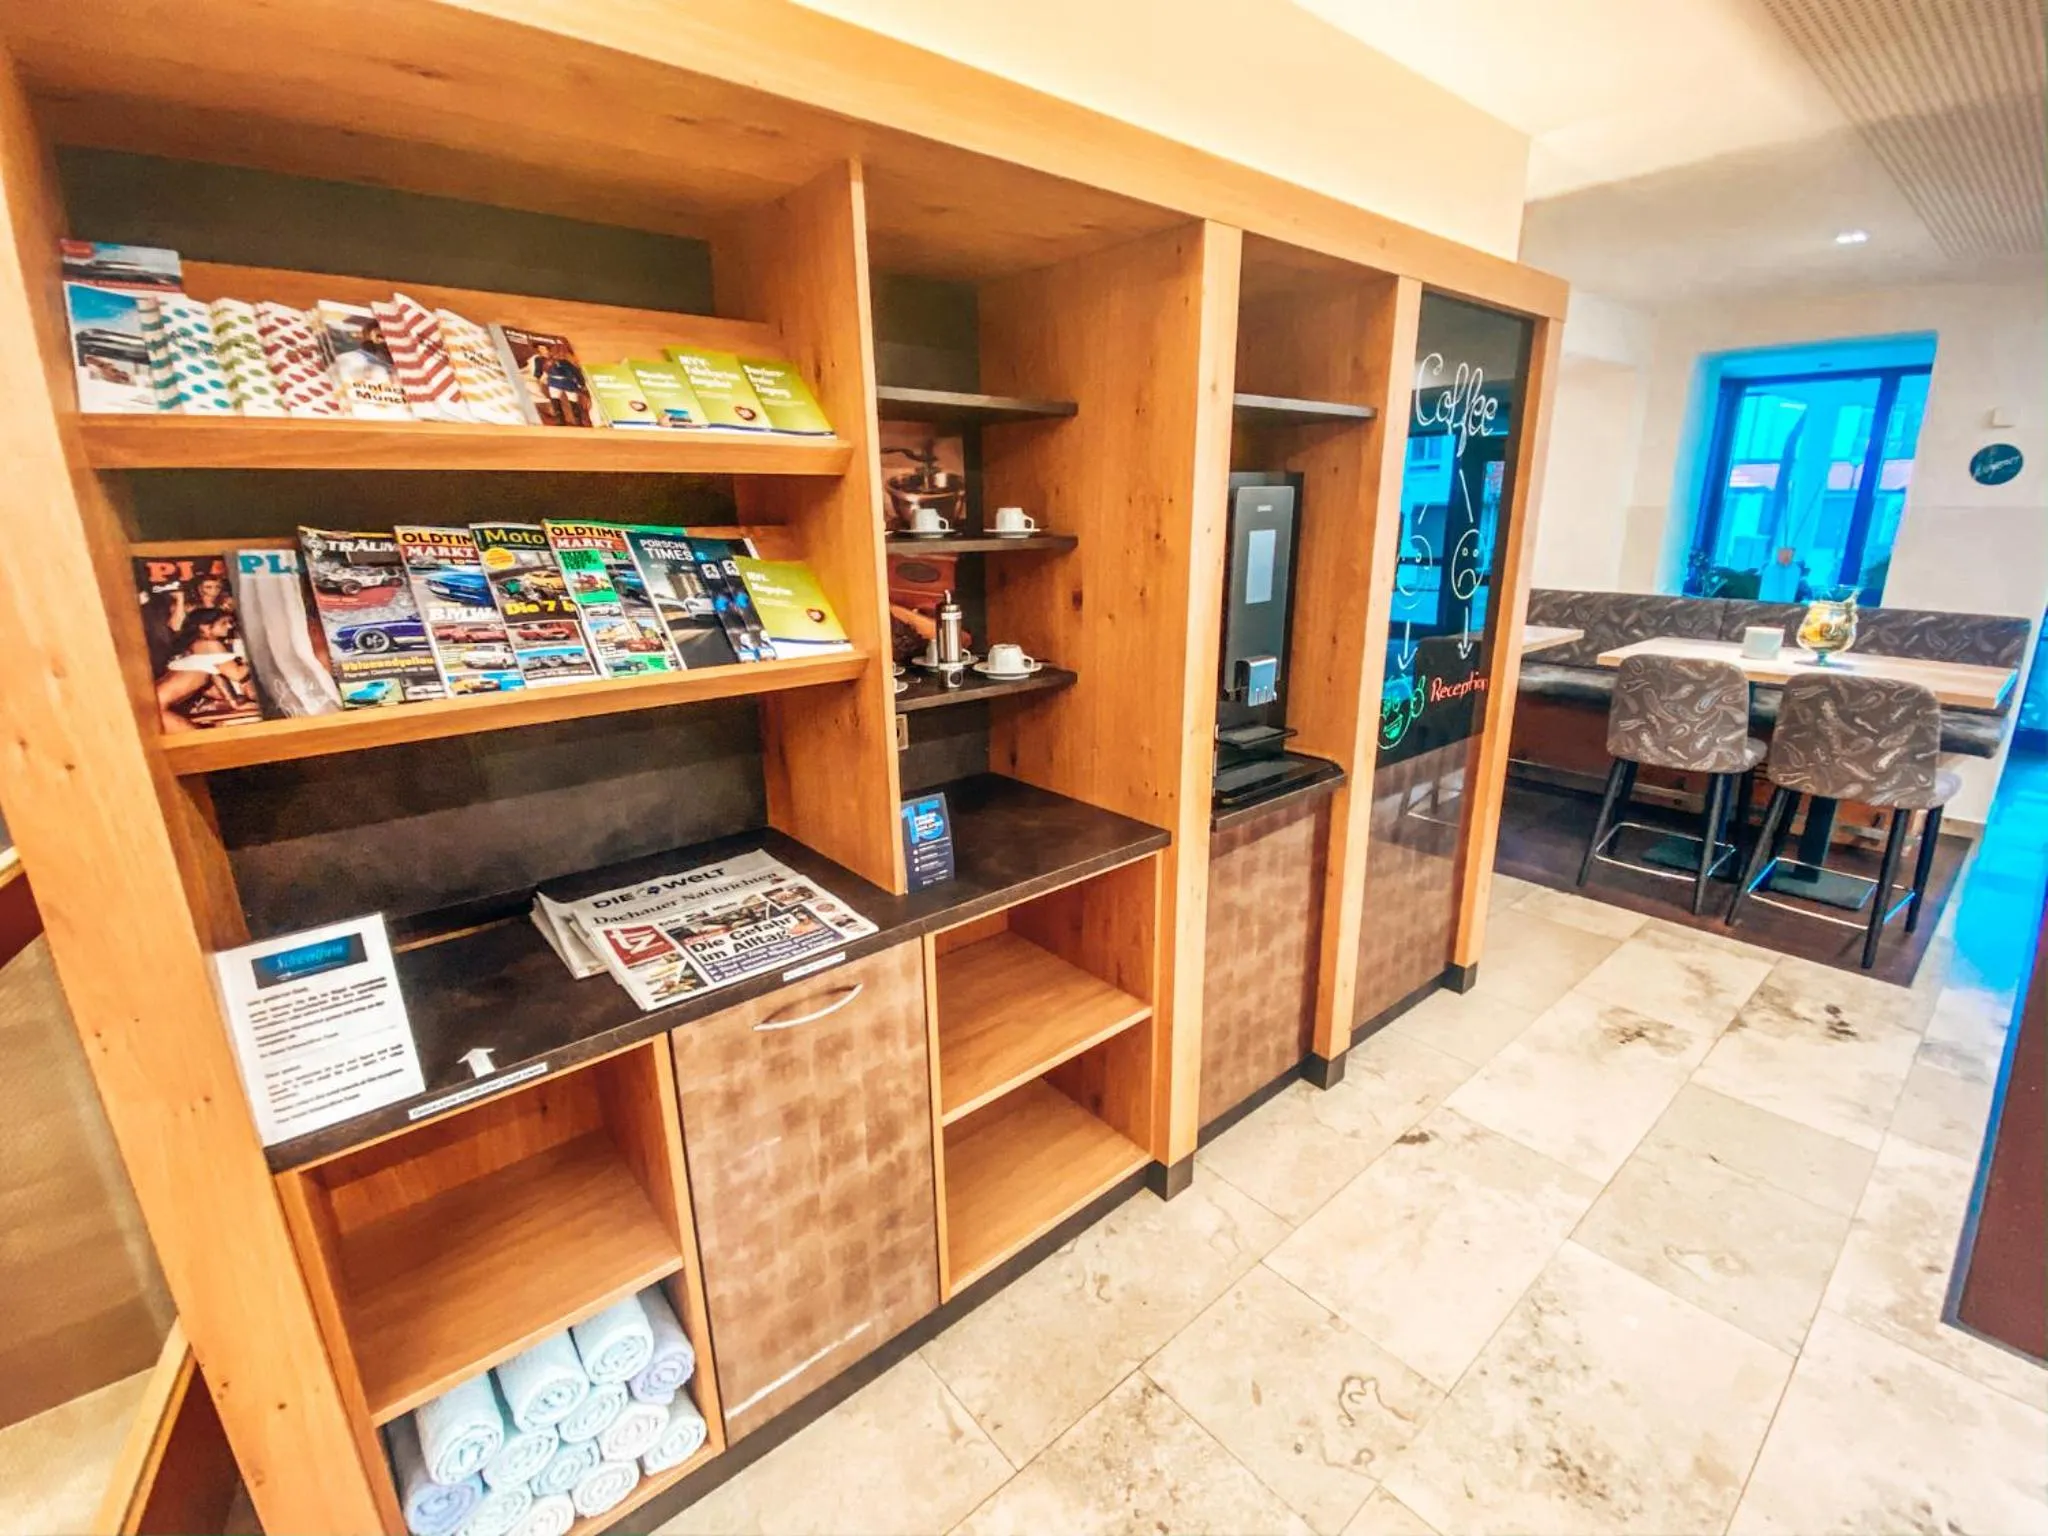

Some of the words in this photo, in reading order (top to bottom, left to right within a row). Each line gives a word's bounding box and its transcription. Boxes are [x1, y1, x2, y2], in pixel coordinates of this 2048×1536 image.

[1415, 353, 1498, 457] Coffee
[484, 529, 545, 544] Moto
[556, 537, 614, 549] MARKT
[406, 545, 475, 558] MARKT
[640, 539, 689, 551] PORSCHE
[646, 549, 694, 561] TIMES
[239, 554, 292, 574] PL
[504, 601, 540, 615] Die
[541, 600, 556, 612] 7
[593, 899, 677, 925] Dachauer
[682, 870, 777, 901] Nachrichten
[593, 893, 635, 909] DIE
[611, 926, 665, 955] tz
[690, 937, 724, 952] Die
[729, 915, 792, 941] Gefahr
[701, 950, 727, 964] im
[733, 929, 792, 954] Alltag
